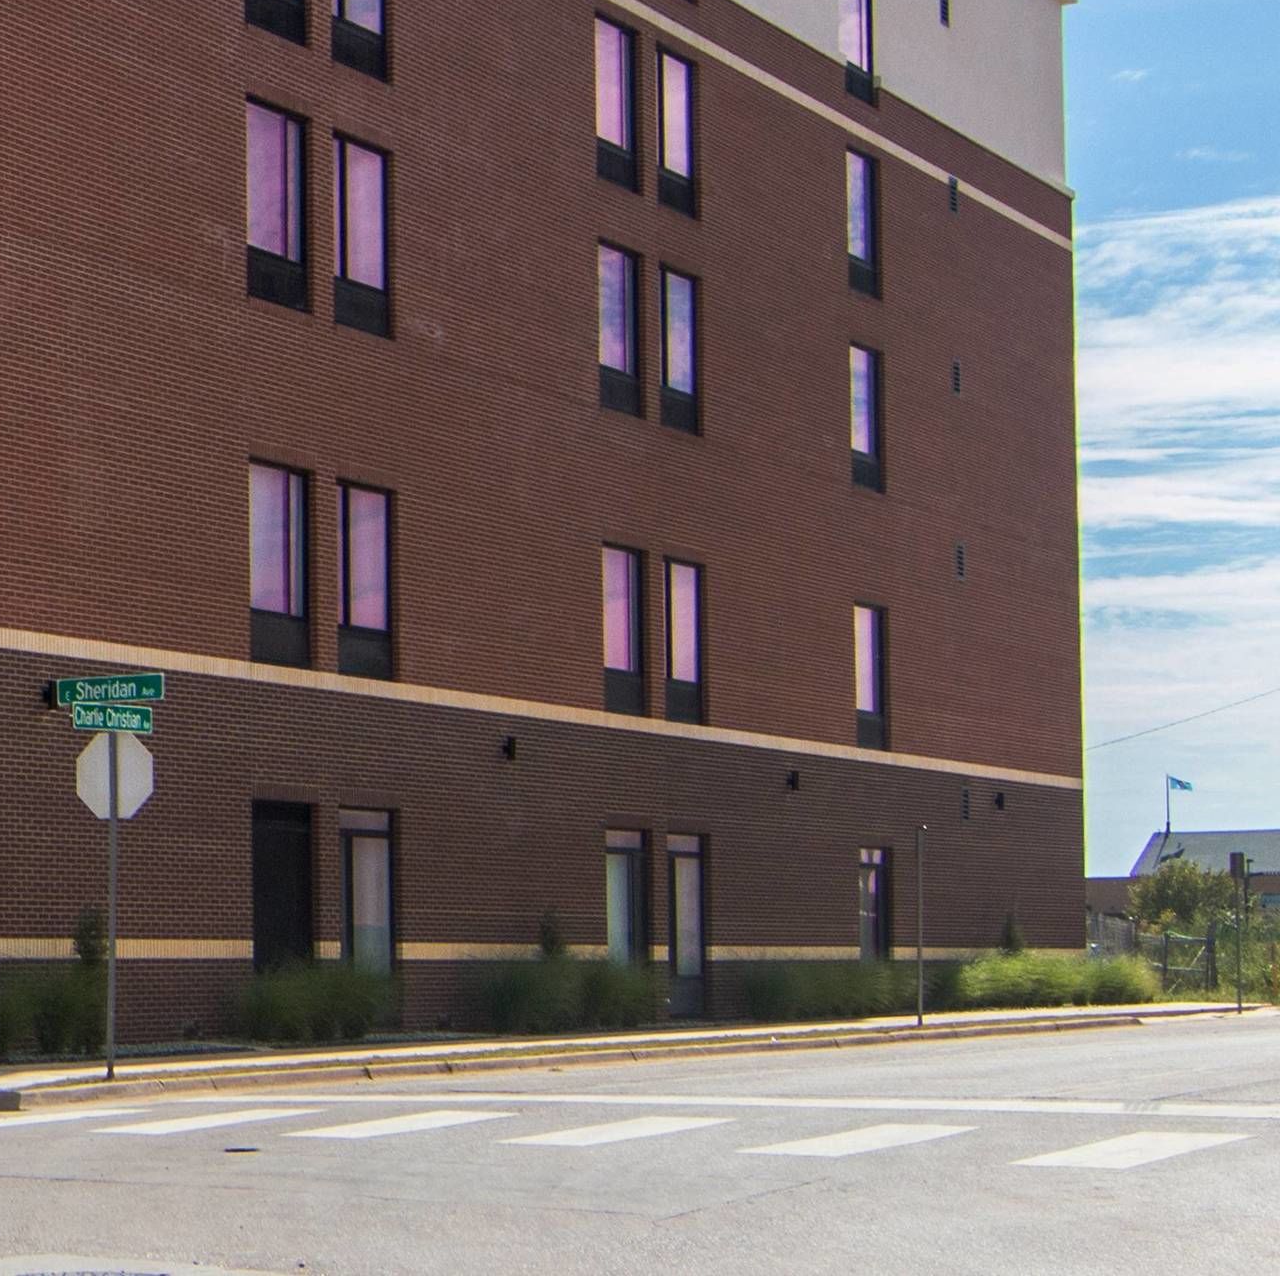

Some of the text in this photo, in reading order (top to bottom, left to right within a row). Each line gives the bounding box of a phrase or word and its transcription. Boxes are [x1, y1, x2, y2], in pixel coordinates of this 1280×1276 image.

[65, 681, 155, 701] E Sheridan Ave
[75, 706, 104, 725] Charlie
[106, 708, 141, 729] Christian
